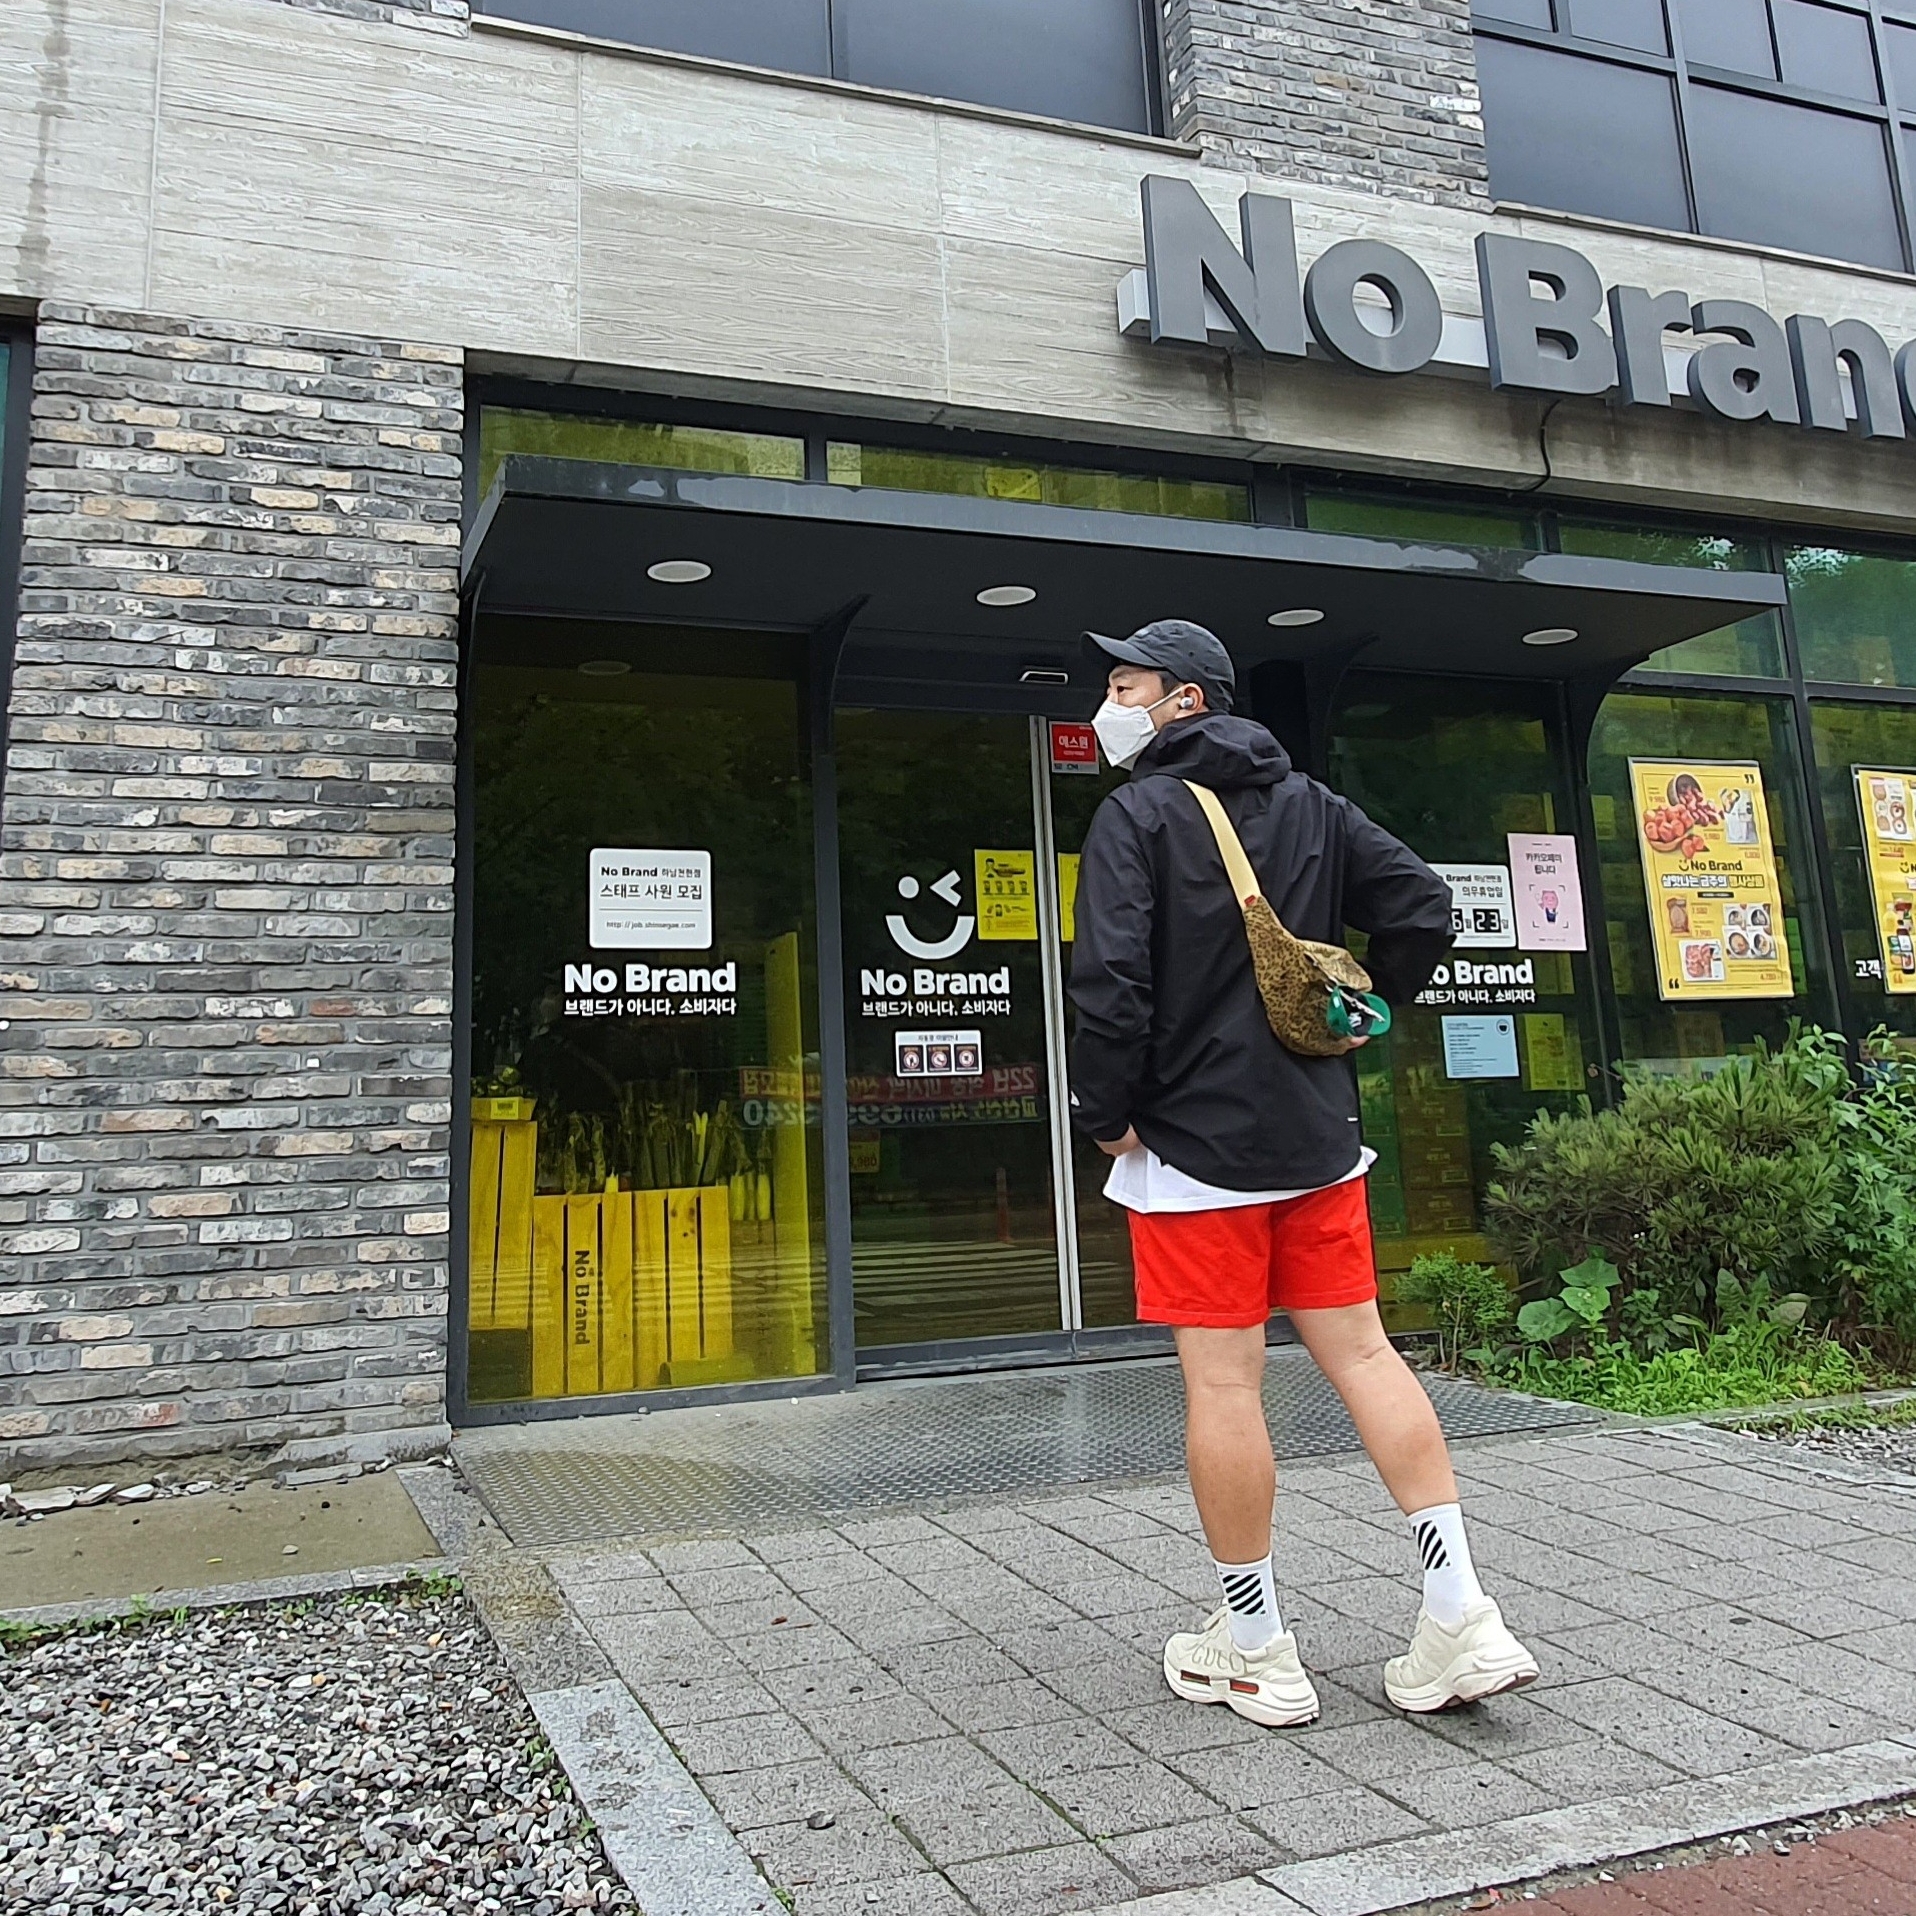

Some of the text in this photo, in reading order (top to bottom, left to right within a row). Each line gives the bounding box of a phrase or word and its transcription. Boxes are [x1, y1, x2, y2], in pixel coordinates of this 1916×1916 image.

[1140, 174, 1916, 440] No Bran
[601, 867, 618, 876] No
[622, 867, 658, 877] Brand
[1691, 860, 1743, 871] No Brand
[1446, 874, 1471, 882] Brand
[600, 884, 702, 900] 스태프 사원 모집
[1476, 911, 1500, 930] 23
[564, 961, 736, 993] No Brand
[861, 966, 1010, 996] No Brand
[1428, 958, 1534, 985] o Brand
[1458, 988, 1493, 1004] 아니다.
[1495, 988, 1536, 1004] 소비자다
[564, 997, 737, 1017] 브랜드가 아니다. 소비자다
[862, 999, 1011, 1017] 브랜드가 아니다. 소비자다
[575, 1250, 590, 1345] No Brand
